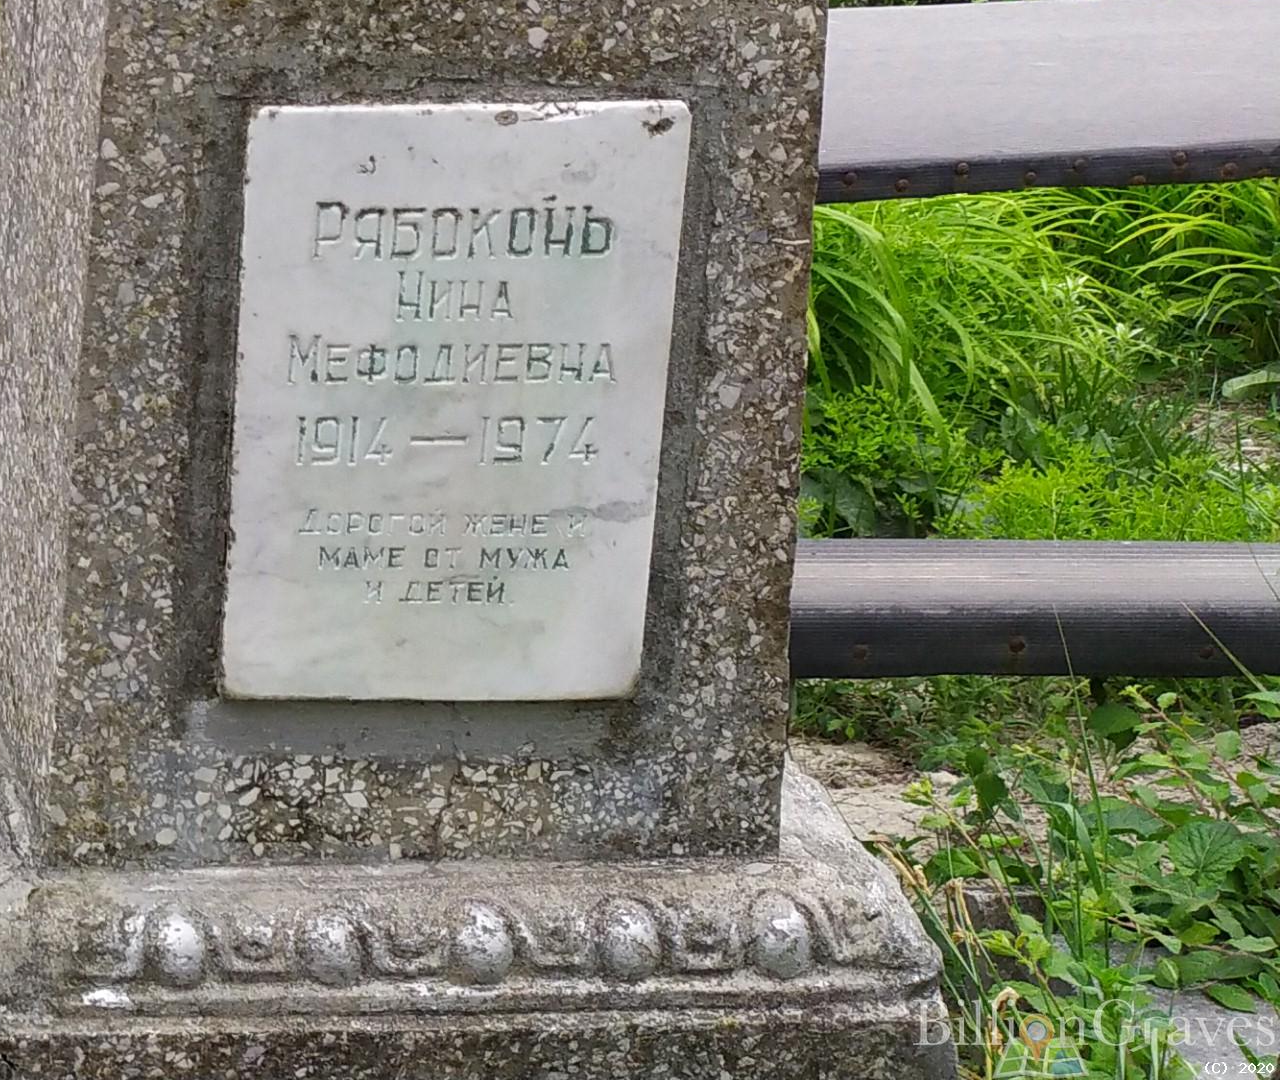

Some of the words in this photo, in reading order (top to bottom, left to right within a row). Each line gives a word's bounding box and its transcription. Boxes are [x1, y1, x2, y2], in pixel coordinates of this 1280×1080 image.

[312, 201, 614, 260] РЯБОКОНЬ
[394, 271, 513, 322] НИНА
[287, 334, 617, 385] МЕФОДИЕВНА
[295, 415, 393, 466] 1914
[477, 415, 599, 466] 1974
[464, 513, 550, 538] ЖЕНЕ
[318, 546, 407, 570] МАМЕ
[424, 547, 463, 569] ОТ
[479, 547, 570, 570] МУЖА
